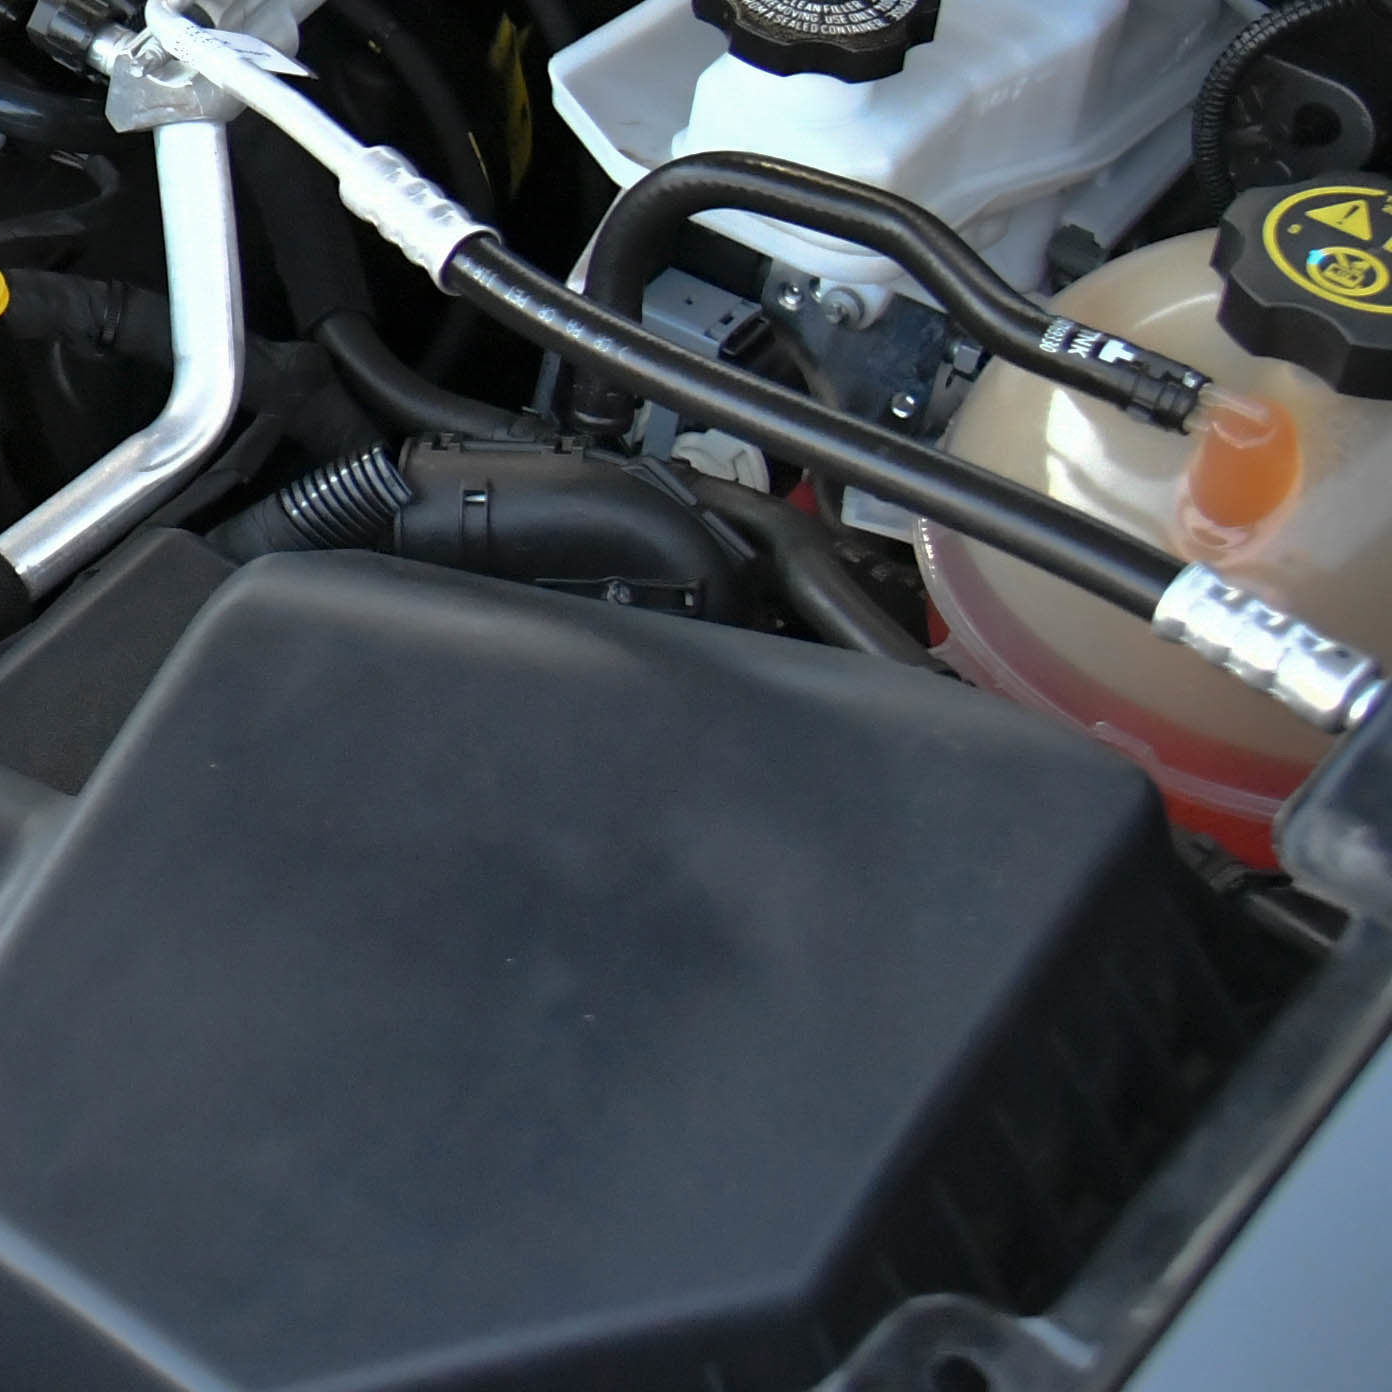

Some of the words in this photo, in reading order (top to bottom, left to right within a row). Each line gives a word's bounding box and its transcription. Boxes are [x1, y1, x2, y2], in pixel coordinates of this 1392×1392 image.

[823, 0, 867, 14] FILLER
[763, 11, 775, 19] A
[773, 14, 818, 33] SEALED
[824, 13, 848, 24] USE
[848, 8, 878, 24] ONLY
